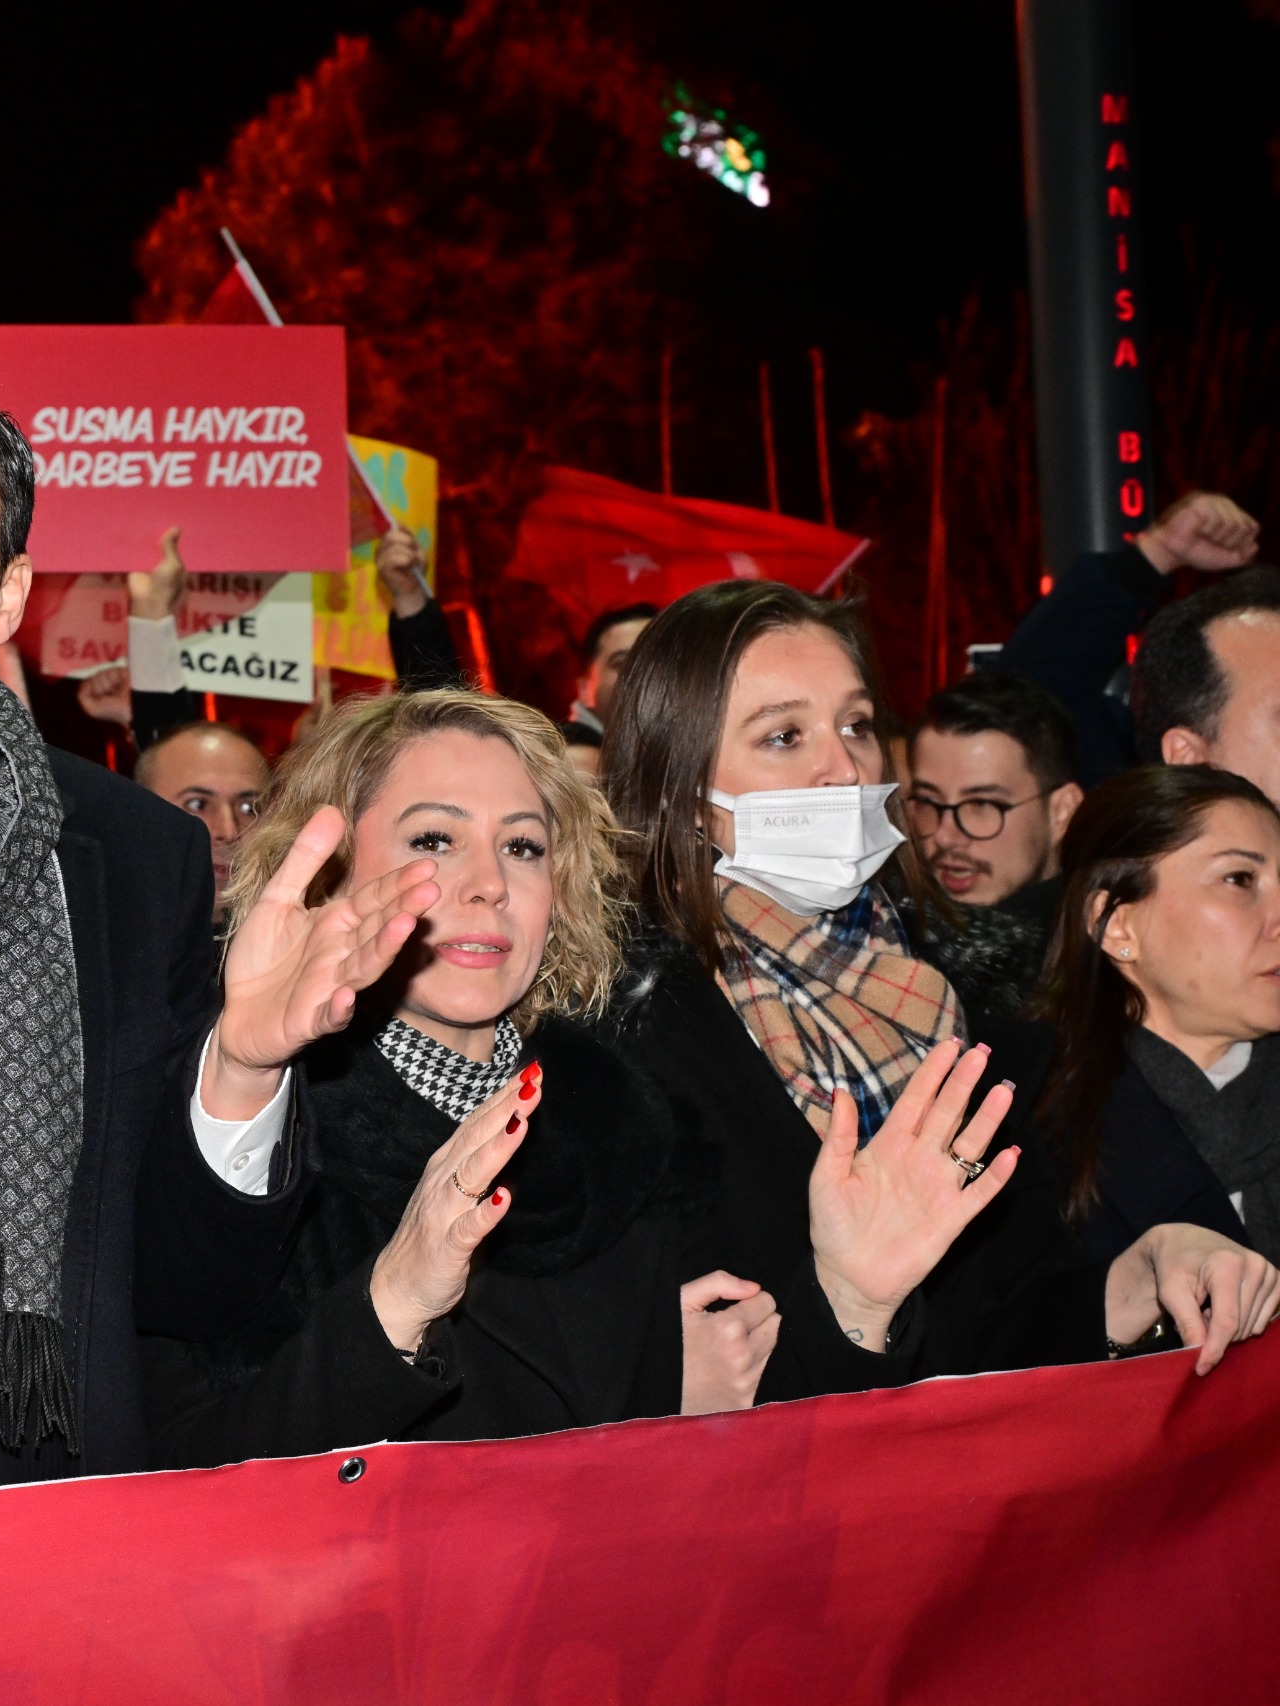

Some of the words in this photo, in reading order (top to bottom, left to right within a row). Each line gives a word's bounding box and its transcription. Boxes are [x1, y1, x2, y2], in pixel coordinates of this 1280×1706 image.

[30, 406, 153, 443] SUSMA
[163, 406, 310, 445] HAYKIR,
[206, 451, 322, 487] HAYIR
[763, 815, 810, 828] ACURA
